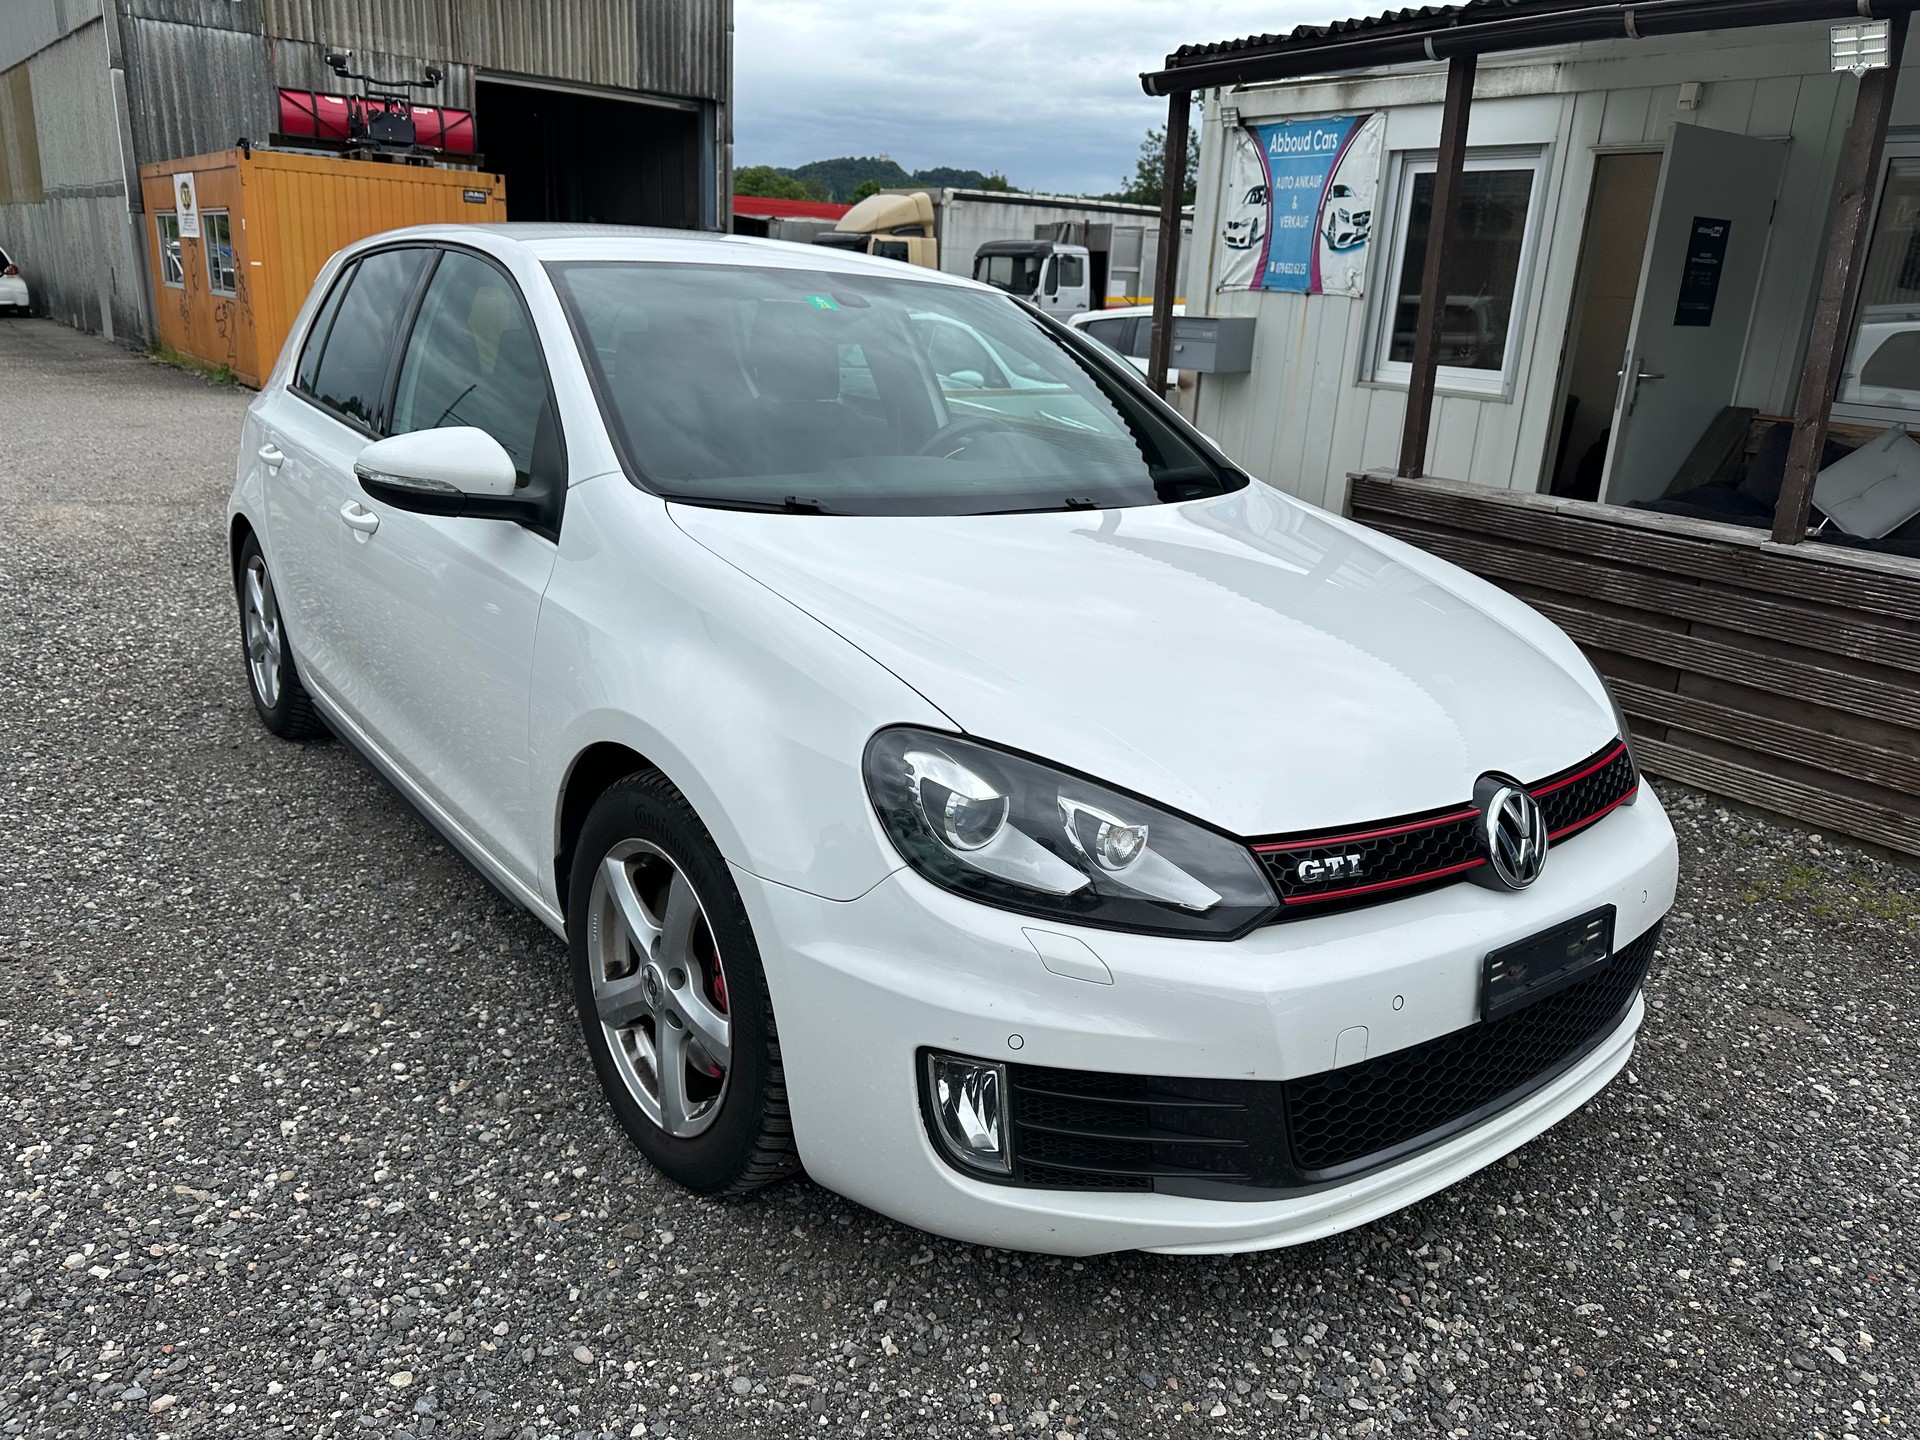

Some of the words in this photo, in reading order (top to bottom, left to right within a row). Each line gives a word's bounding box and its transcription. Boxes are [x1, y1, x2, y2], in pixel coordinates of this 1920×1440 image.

[1270, 131, 1311, 153] Abboud
[1313, 130, 1338, 150] Cars
[1275, 176, 1295, 190] AUTO
[1294, 174, 1323, 189] ANKAUF
[1291, 196, 1298, 210] &
[1280, 215, 1309, 229] VERKAUF
[1298, 854, 1363, 883] GTI
